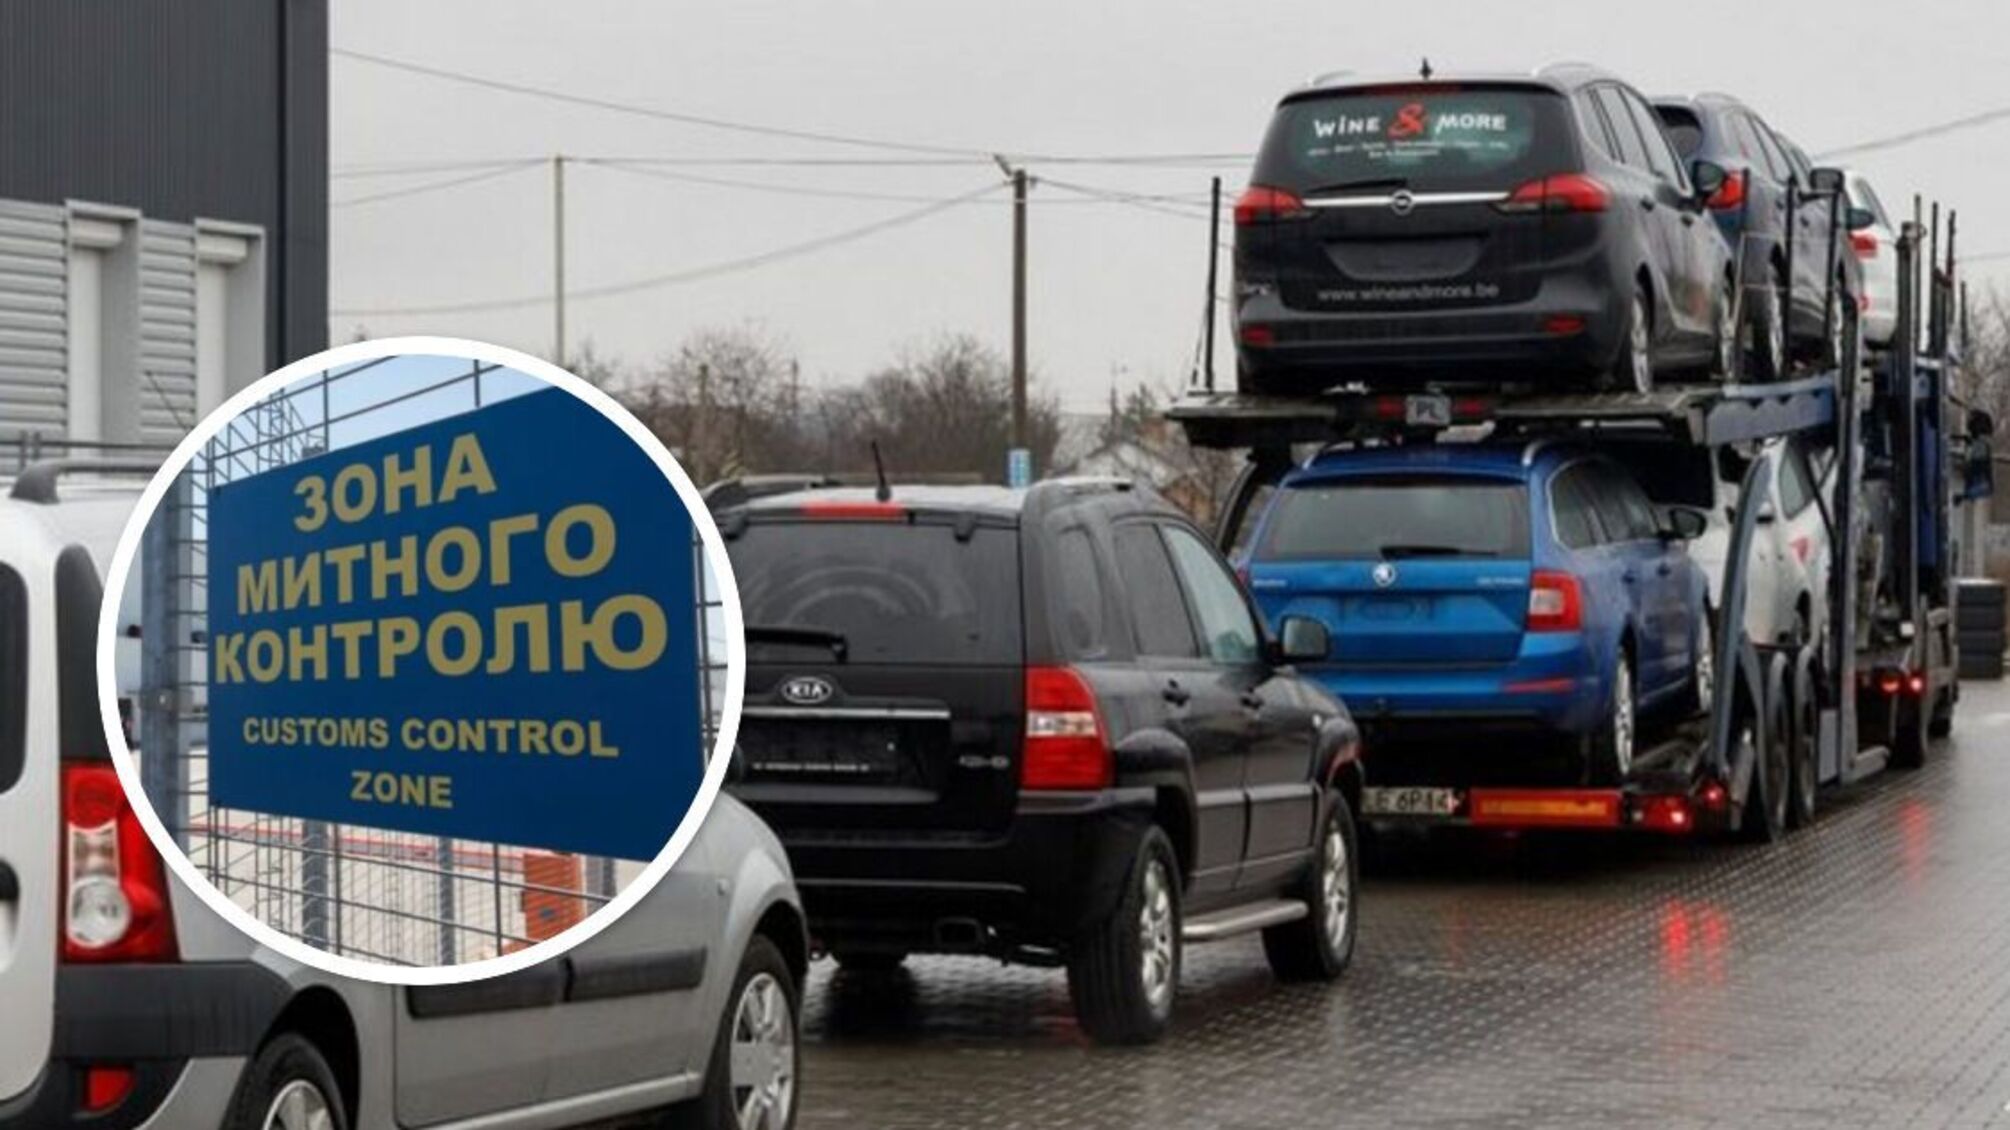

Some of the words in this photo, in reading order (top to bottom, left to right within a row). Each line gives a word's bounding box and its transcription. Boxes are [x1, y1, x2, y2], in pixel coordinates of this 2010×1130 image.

[1387, 103, 1427, 140] &
[1434, 113, 1508, 135] MORE
[294, 433, 497, 532] ЗОНА
[237, 504, 616, 615] МИТНОГО
[215, 595, 668, 684] КОНТРОЛЮ
[243, 717, 389, 747] CUSTOMS
[401, 719, 619, 757] CONTROL
[350, 771, 453, 808] ZONE
